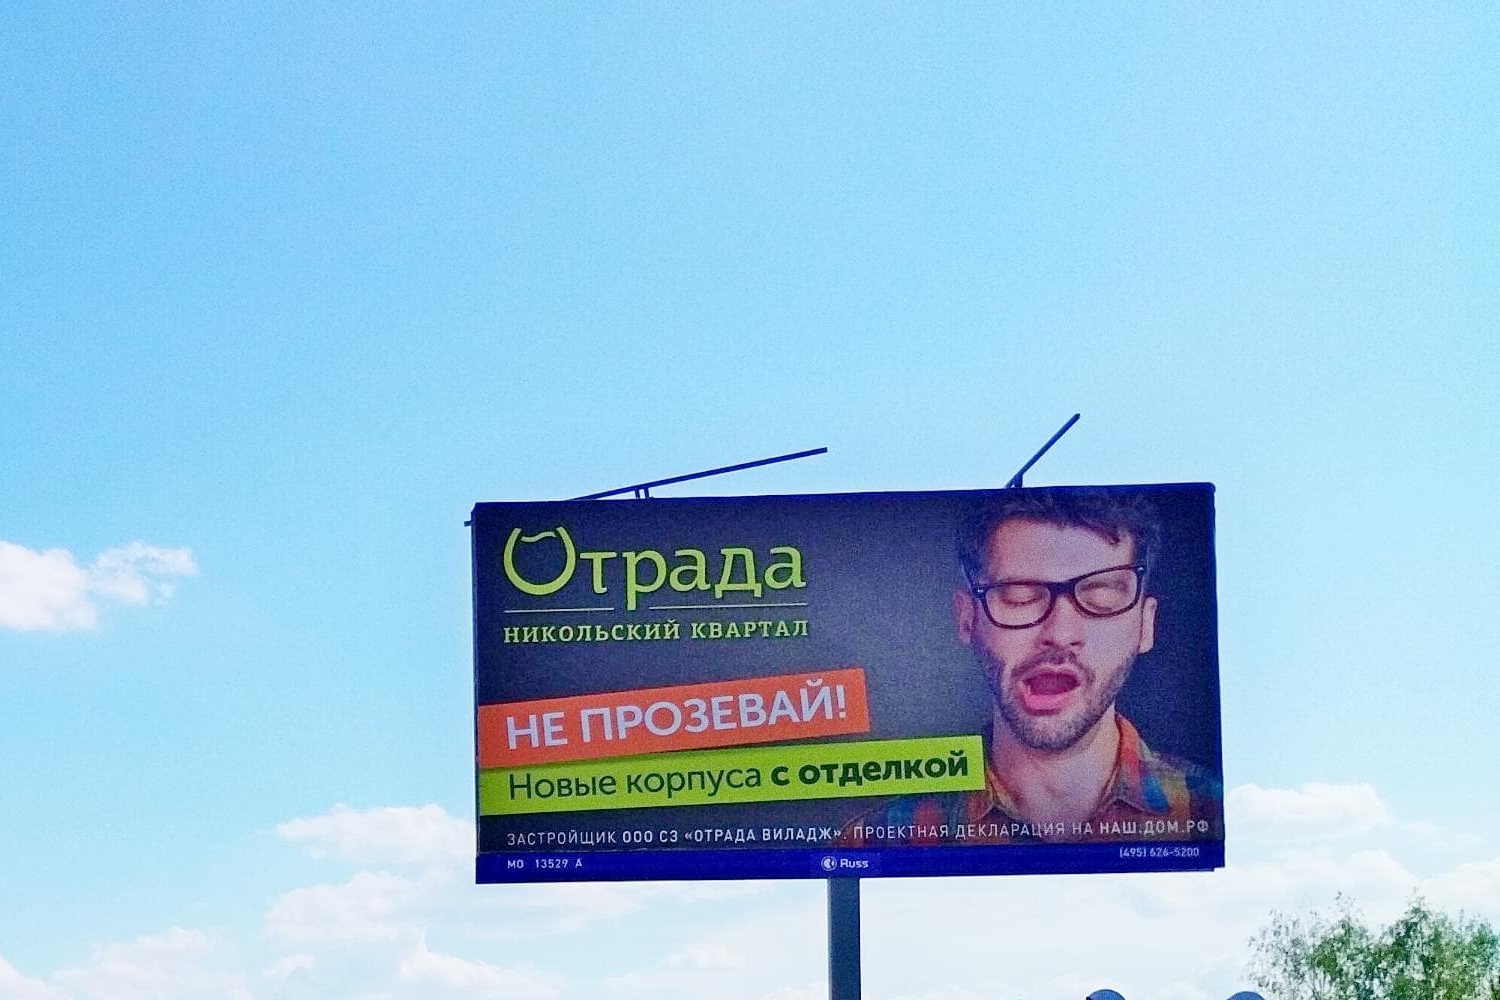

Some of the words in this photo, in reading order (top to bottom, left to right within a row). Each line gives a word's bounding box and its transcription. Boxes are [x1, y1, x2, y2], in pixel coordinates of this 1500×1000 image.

[503, 526, 807, 611] Отрада
[503, 619, 681, 644] НИКОЛЬСКИЙ
[690, 619, 809, 640] КВАРТАЛ
[505, 711, 569, 750] НЕ
[580, 678, 847, 744] ПРОЗЕВАЙ!
[508, 772, 617, 801] Новые
[626, 766, 762, 799] корпуса
[770, 765, 791, 787] с
[798, 749, 969, 787] отделкой
[507, 829, 617, 847] ЗАСТРОЙЩИК
[622, 830, 653, 844] ООО
[685, 828, 756, 844] «ОТРАДА
[853, 824, 949, 841] ПРОЕКТНАЯ
[955, 822, 1066, 840] ДЕКЛАРАЦИЯ
[1071, 821, 1094, 835] НА
[1099, 819, 1210, 835] НАШ.ДОМ.РФ
[507, 858, 525, 869] МО
[534, 858, 569, 869] 13529
[839, 858, 869, 869] Russ
